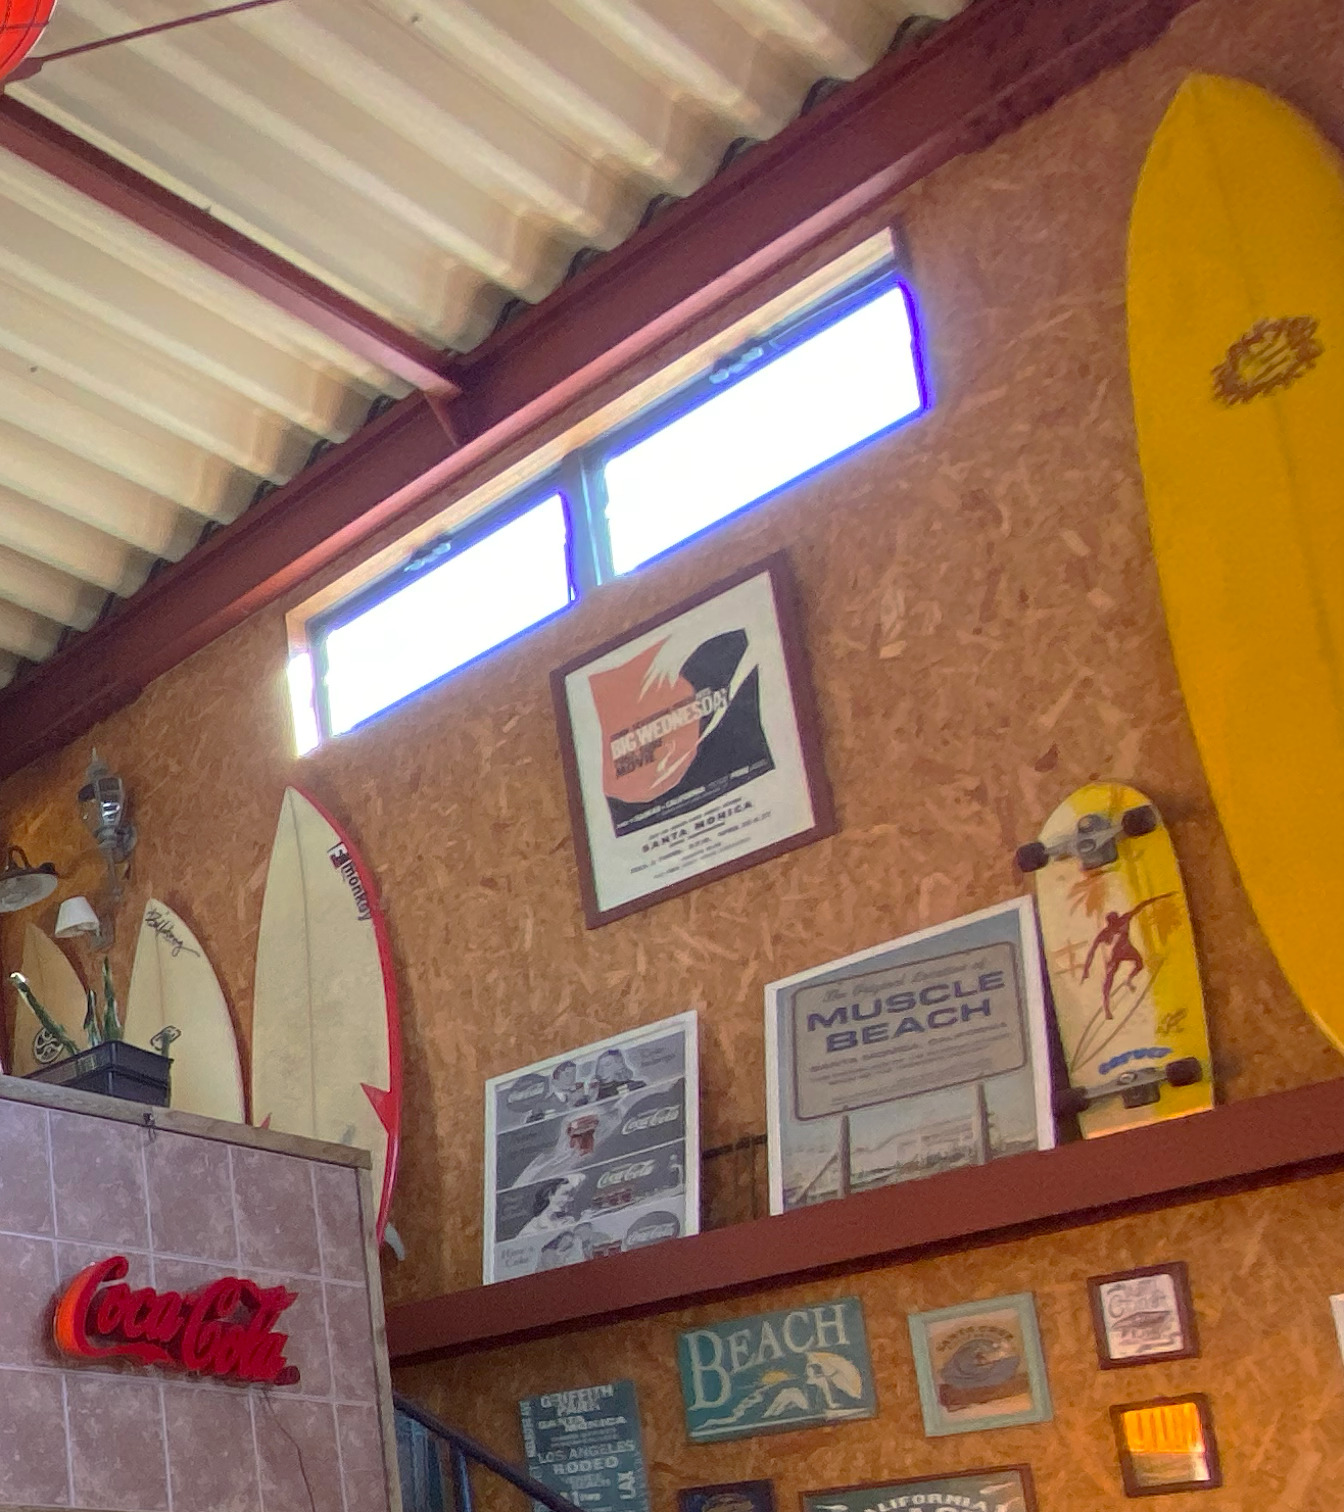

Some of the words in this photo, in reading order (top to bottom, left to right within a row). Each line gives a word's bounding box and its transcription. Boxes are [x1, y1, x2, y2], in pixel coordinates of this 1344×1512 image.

[642, 829, 688, 852] SANTA
[694, 801, 753, 831] MONICA
[807, 971, 1006, 1032] MUSCLE
[826, 999, 991, 1053] BEACH
[54, 1255, 301, 1386] Coca-Cola
[683, 1303, 851, 1411] BEACH
[552, 1456, 620, 1475] RODEO
[569, 1440, 636, 1460] ANGELES
